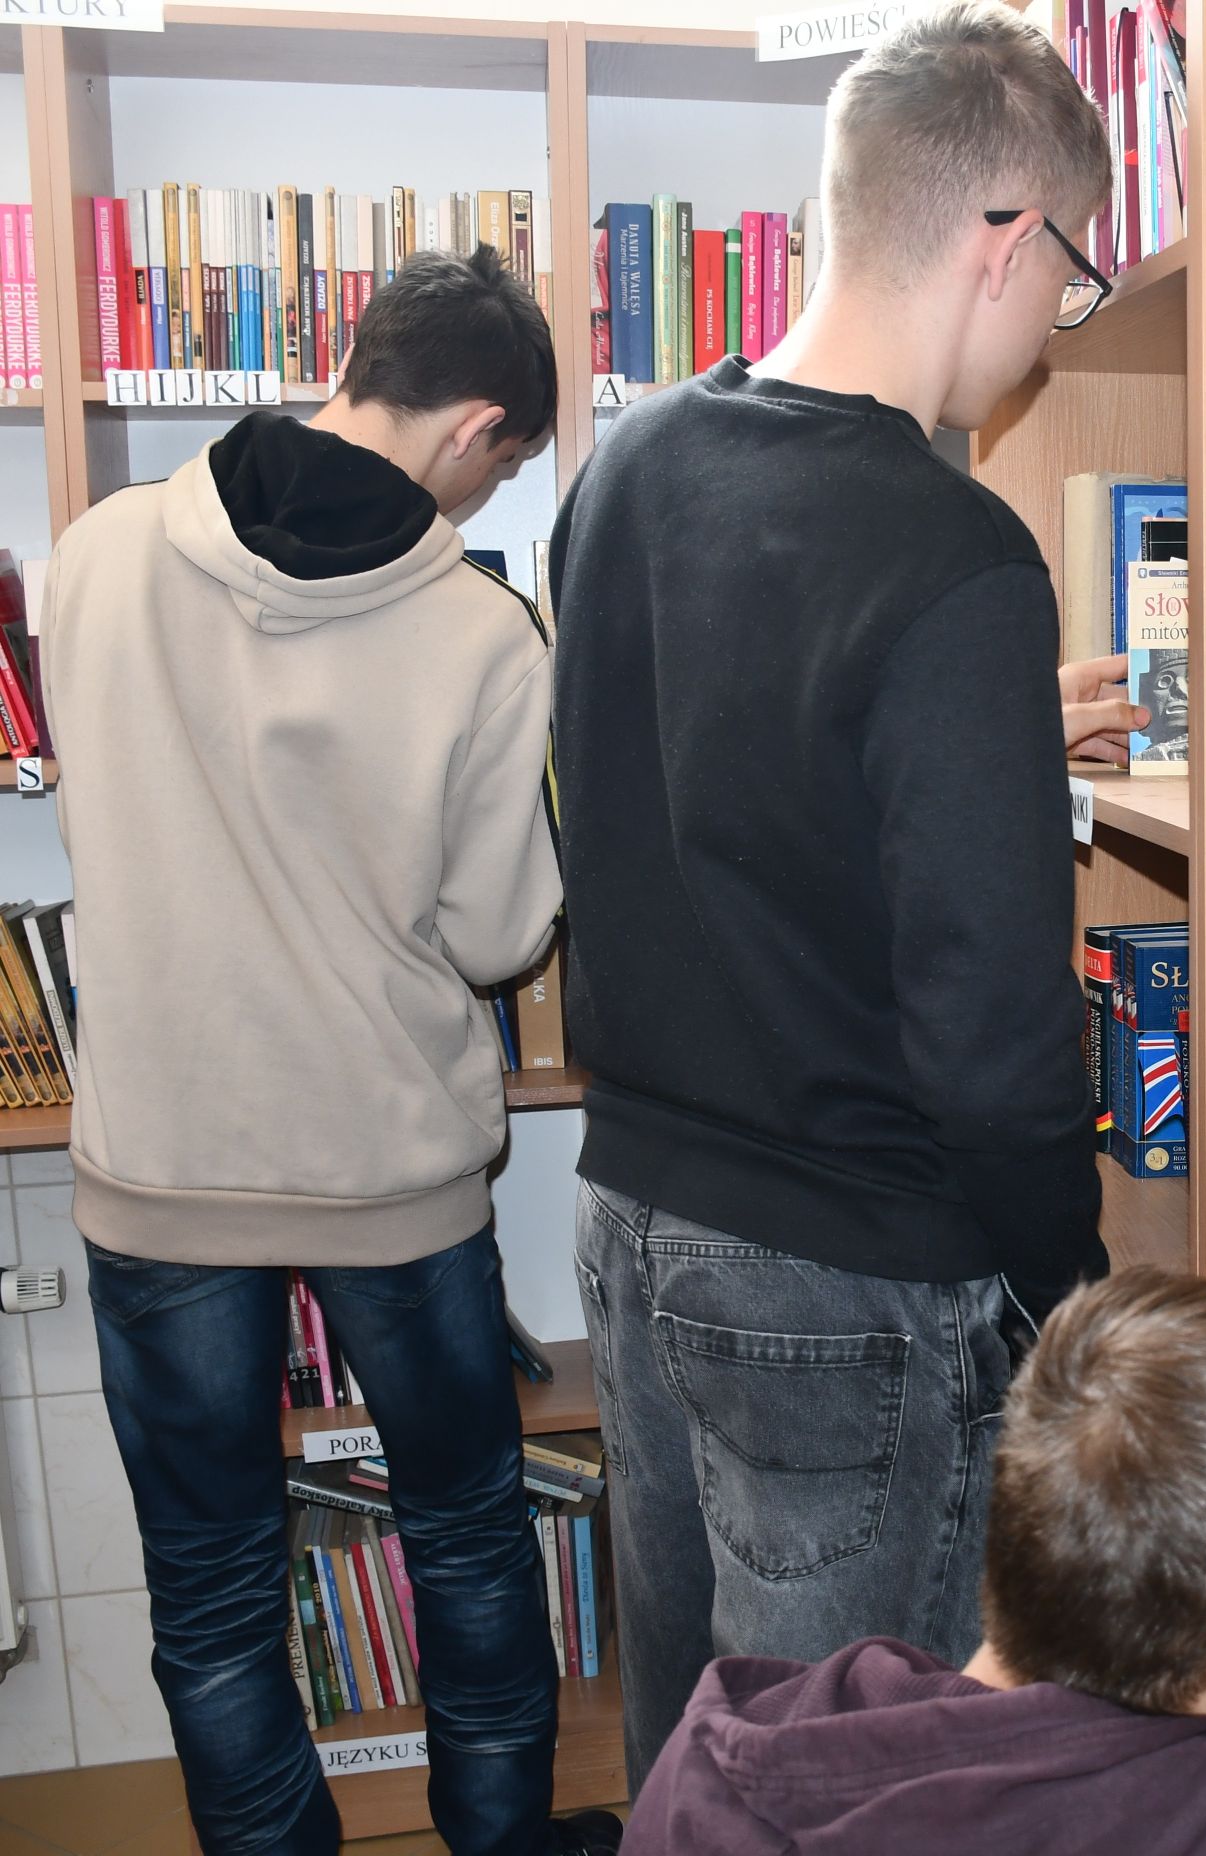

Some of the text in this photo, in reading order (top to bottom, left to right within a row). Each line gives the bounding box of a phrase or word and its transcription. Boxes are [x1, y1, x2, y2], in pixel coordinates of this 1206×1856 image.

[620, 228, 629, 311] Marzenia tajemnice
[628, 223, 641, 316] DANUTA WAŁĘSA
[317, 274, 326, 310] DZIADY
[4, 283, 25, 371] FERDYDURKE
[99, 276, 121, 363] FERDYDURKE
[113, 372, 279, 403] H I J K L
[597, 375, 623, 405] A
[20, 758, 41, 789] S
[533, 1057, 554, 1067] IBIS
[1093, 1008, 1102, 1103] ANGIELSKO-POLSKI
[289, 1370, 298, 1382] 4
[302, 1368, 310, 1379] 2
[312, 1367, 320, 1378] 1
[292, 1484, 364, 1515] kaleidoskop
[312, 1583, 322, 1604] 2010
[327, 1743, 409, 1769] JĘZYKU
